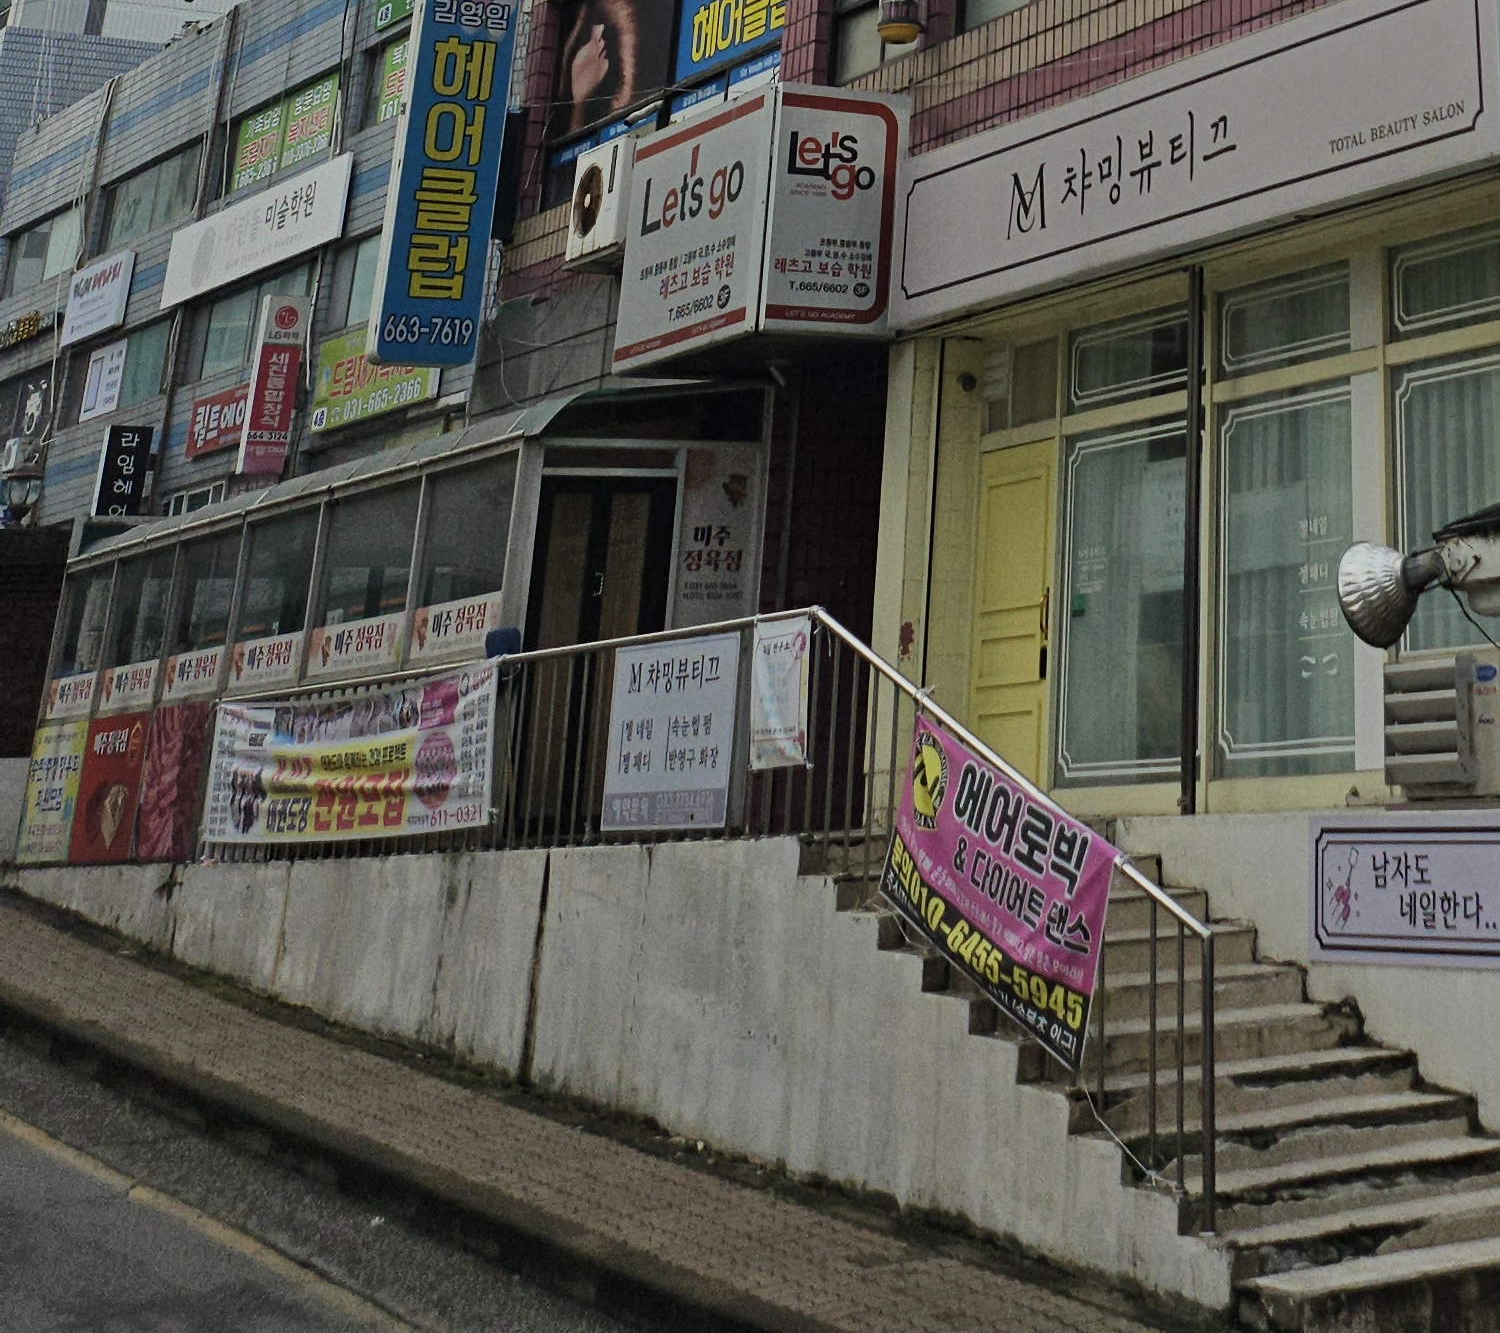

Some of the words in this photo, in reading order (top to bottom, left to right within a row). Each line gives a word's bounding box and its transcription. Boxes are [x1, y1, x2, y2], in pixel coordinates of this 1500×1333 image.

[1328, 131, 1367, 156] TOTAL
[1370, 116, 1419, 146] BEAUTY
[1422, 99, 1466, 129] SALON
[406, 35, 499, 302] 헤어클럽
[708, 159, 745, 221] go
[264, 180, 318, 232] 미술학원
[714, 251, 736, 282] 학원
[774, 257, 813, 275] 레츠고
[847, 262, 873, 280] 학원
[383, 313, 474, 347] 663-7619
[429, 803, 483, 827] 611-0321
[953, 758, 1093, 900] 에어로빅
[1371, 851, 1432, 890] 남자도
[969, 844, 1046, 931] 다이어트
[1044, 900, 1093, 957] 댄스
